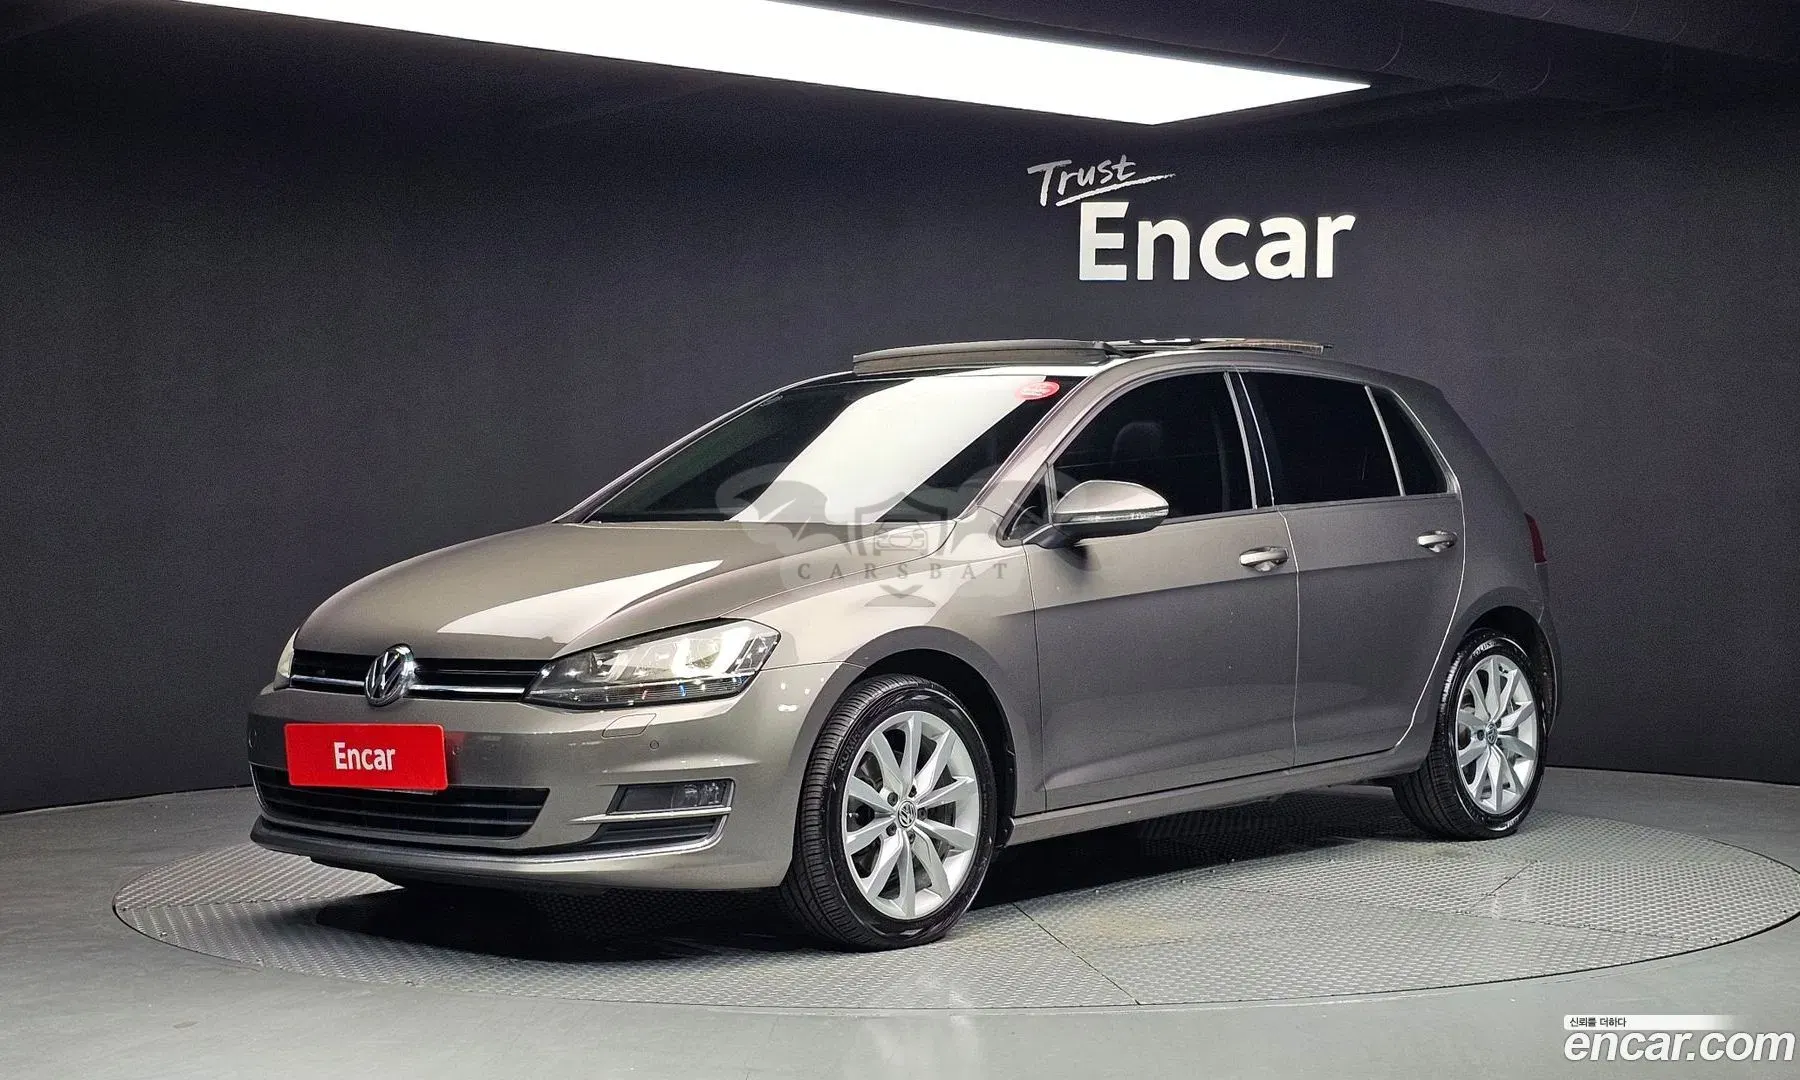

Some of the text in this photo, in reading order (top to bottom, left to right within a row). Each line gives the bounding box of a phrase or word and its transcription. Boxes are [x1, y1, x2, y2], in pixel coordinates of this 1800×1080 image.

[1027, 154, 1138, 207] Trust
[1079, 201, 1356, 281] Encar
[333, 741, 396, 771] Encar
